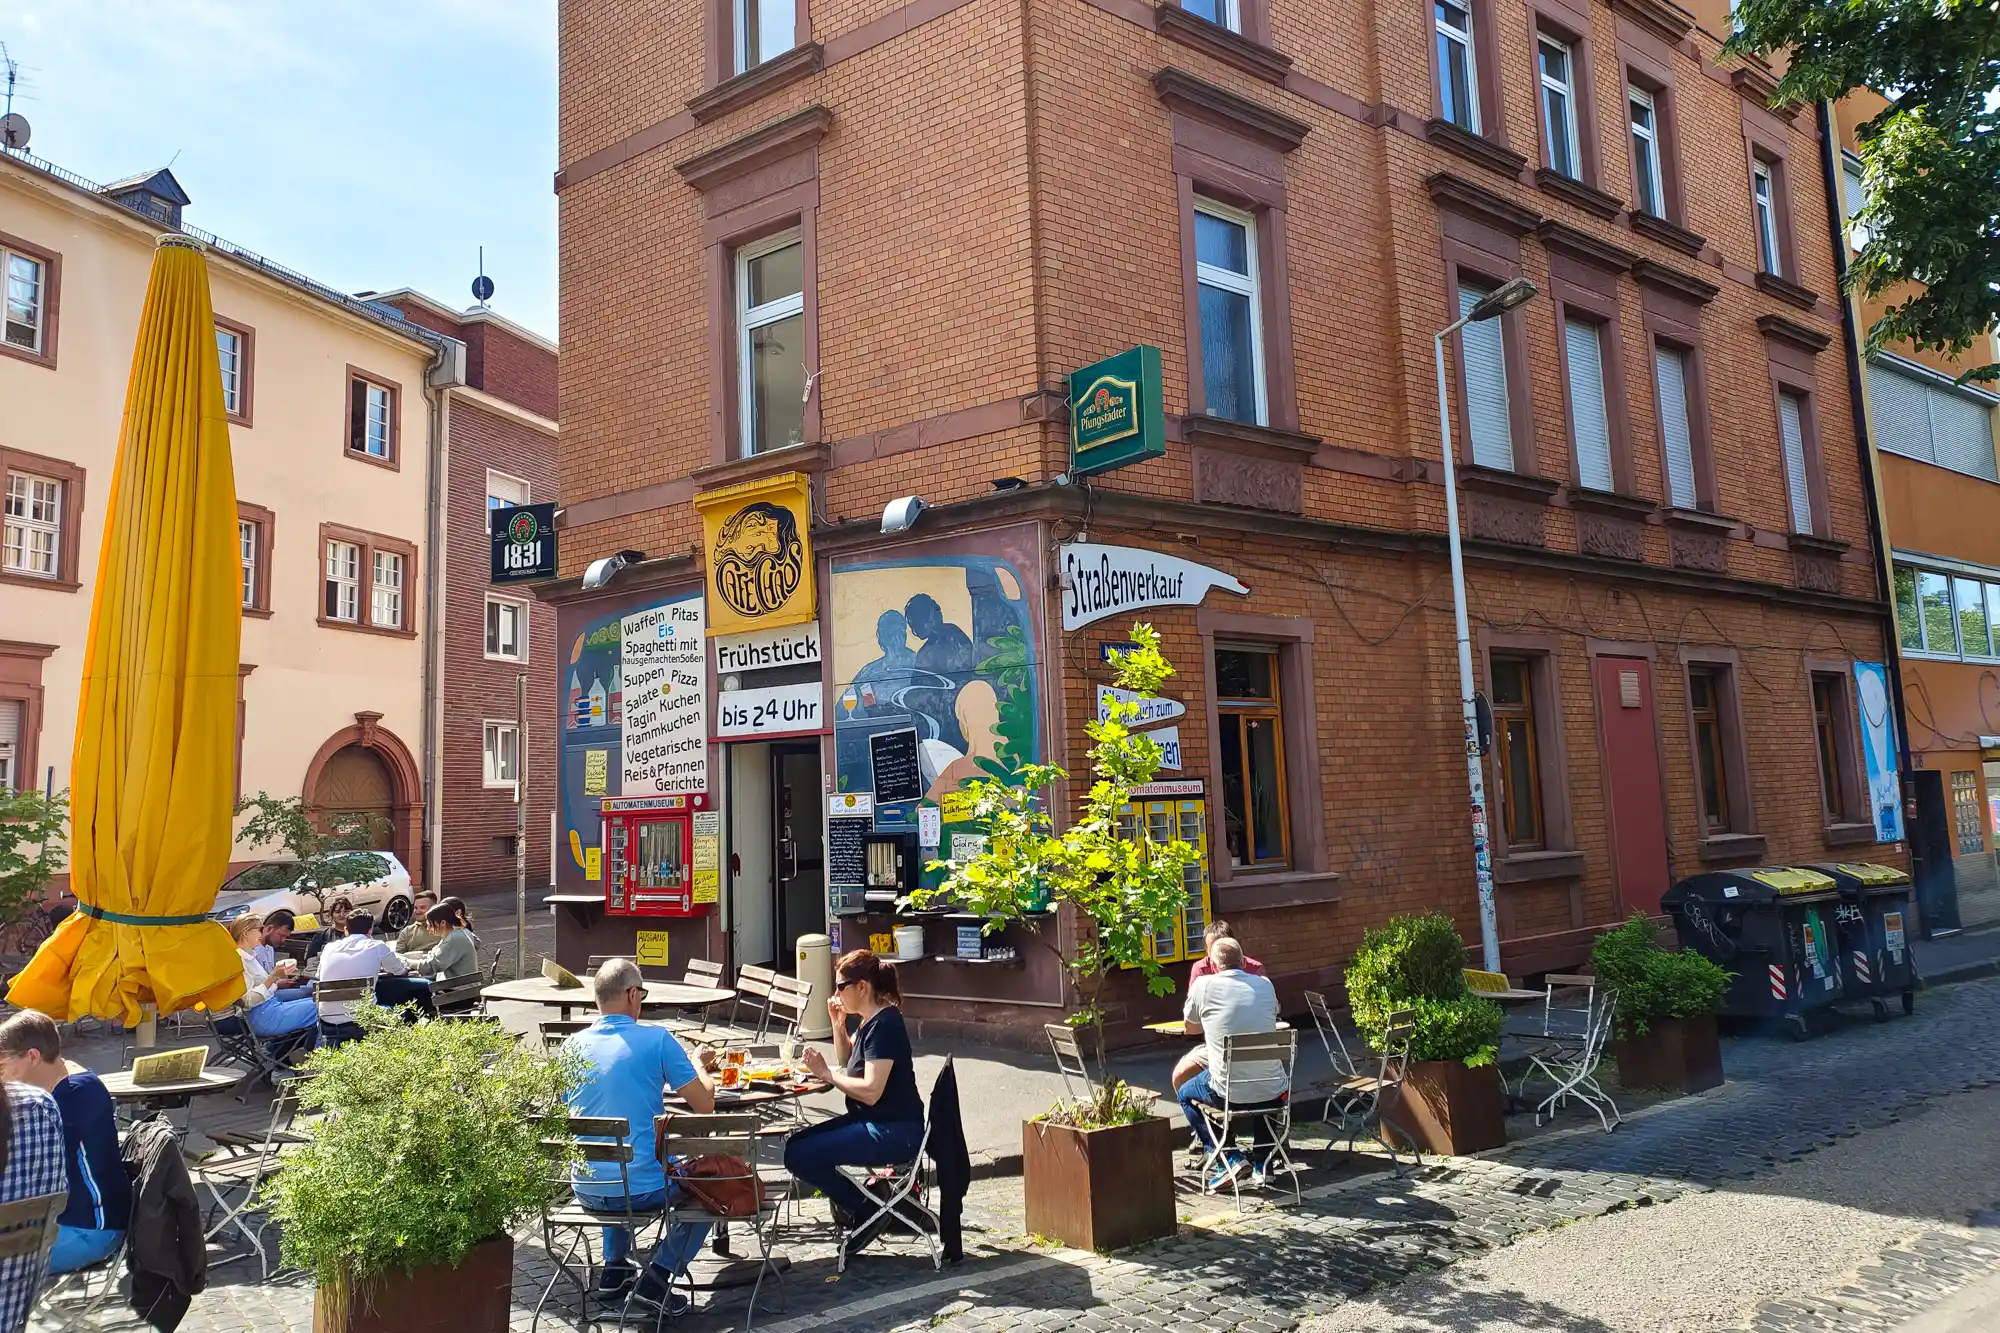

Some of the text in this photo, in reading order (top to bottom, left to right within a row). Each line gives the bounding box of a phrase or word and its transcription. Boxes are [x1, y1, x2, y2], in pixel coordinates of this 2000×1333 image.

[504, 540, 541, 570] 1831
[1067, 553, 1183, 617] Straßenverkauf
[624, 606, 699, 636] Waffeln Pitas
[658, 624, 674, 638] Eis
[625, 637, 698, 656] Spaghetti mit
[719, 635, 817, 669] Frühstück
[624, 667, 698, 688] Suppen Pizza
[626, 688, 659, 713] Salate
[659, 693, 701, 712] Kuchen
[1156, 702, 1173, 717] zum
[627, 710, 657, 729] Tagin
[723, 699, 817, 727] bis 24 Uhr
[626, 711, 701, 748] Flammkuchen
[626, 737, 702, 764] Vegetarische
[655, 775, 705, 791] Gerichte
[1128, 783, 1201, 796] omatenmuseum
[612, 797, 675, 810] AUTOMATENMUSEUM
[638, 931, 666, 943] AUSGANG
